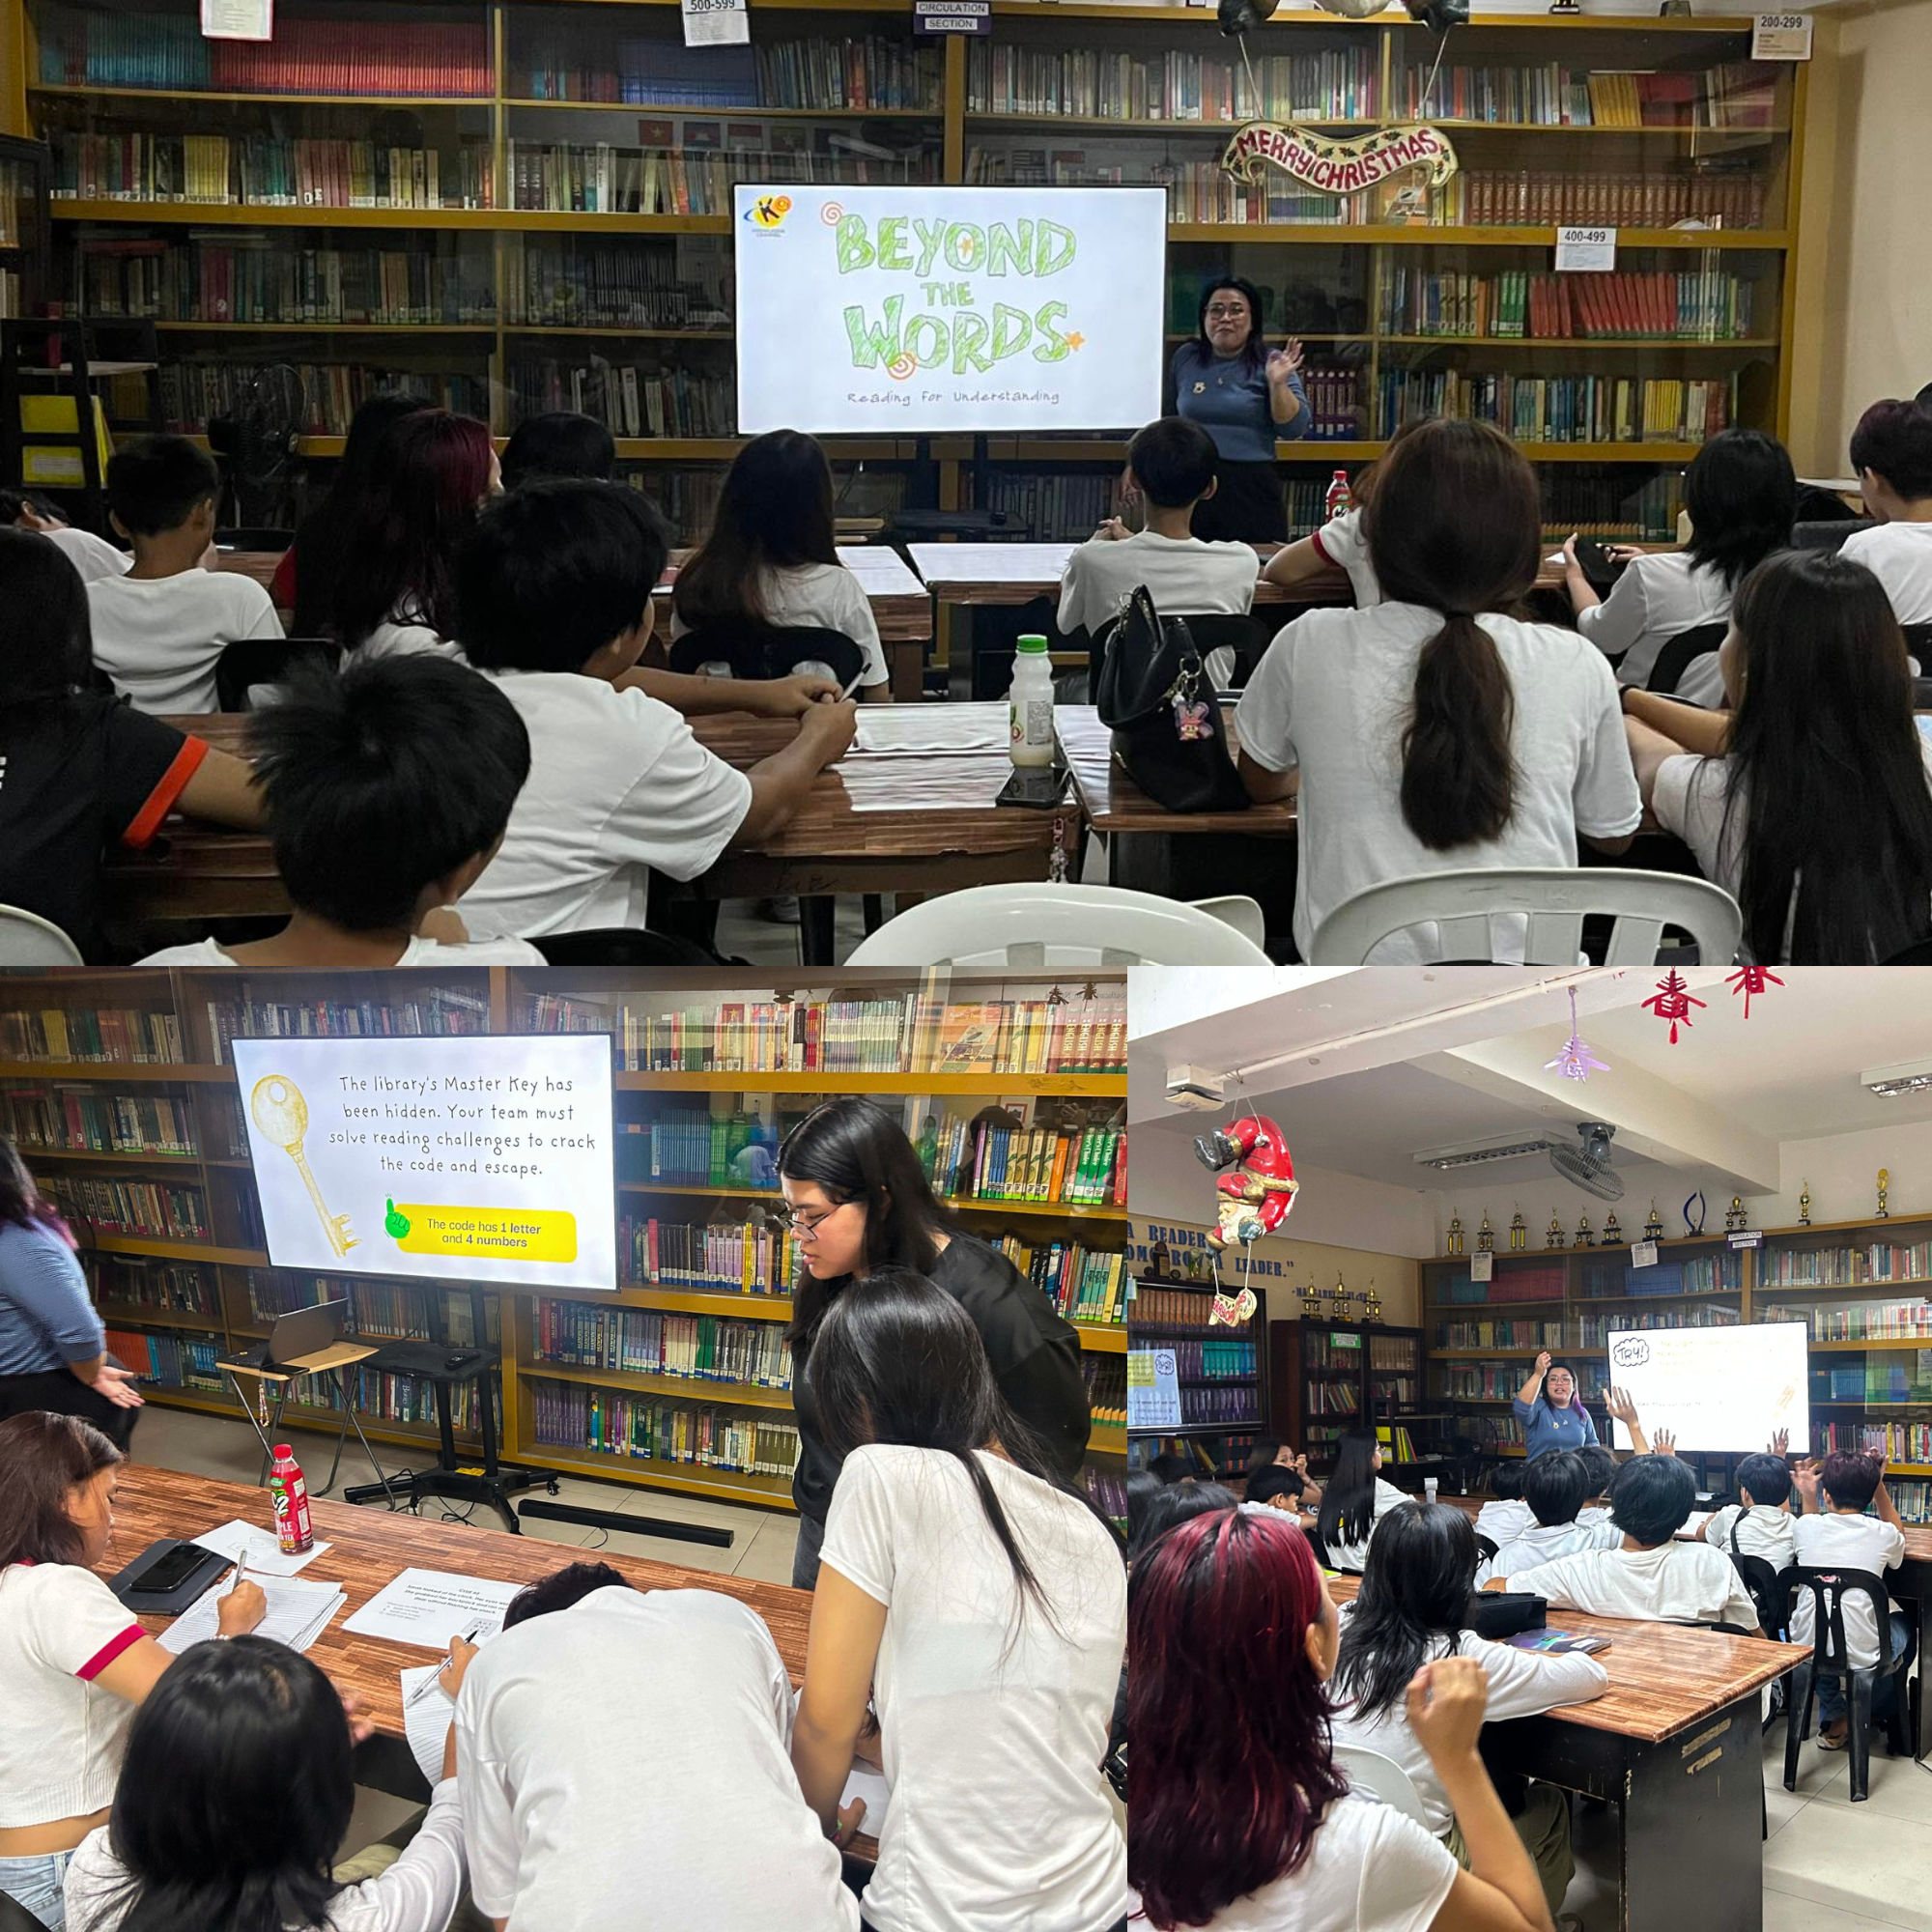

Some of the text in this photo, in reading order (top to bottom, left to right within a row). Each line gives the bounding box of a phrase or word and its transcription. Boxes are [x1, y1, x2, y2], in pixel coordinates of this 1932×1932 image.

[690, 0, 736, 11] 500-599
[918, 3, 985, 14] CIRCULATION
[928, 18, 973, 29] SECTION
[1761, 14, 1803, 28] 200-299
[1236, 129, 1438, 189] MERRY CHRISTMAS
[836, 213, 1077, 277] BEYOND
[1565, 230, 1606, 242] 400-499
[920, 281, 975, 306] THE
[843, 294, 1070, 375] WORDS
[847, 390, 911, 406] Reading
[952, 390, 1060, 405] Understanding
[1063, 1023, 1077, 1051] ENGLISH
[1077, 1023, 1092, 1051] ENGLISH
[1093, 1022, 1107, 1051] ENGLISH
[1107, 1023, 1122, 1051] ENGLISH
[339, 1075, 573, 1096] The library's Master Key has
[343, 1103, 575, 1121] been hidden. Your team must
[328, 1129, 596, 1156] solve reading challenges to crack
[381, 1155, 543, 1179] the code and escape.
[427, 1218, 542, 1235] The code has 1 letter
[1148, 1224, 1207, 1248] READER
[441, 1233, 527, 1248] and 4 numbers
[1617, 1345, 1645, 1361] TRY!
